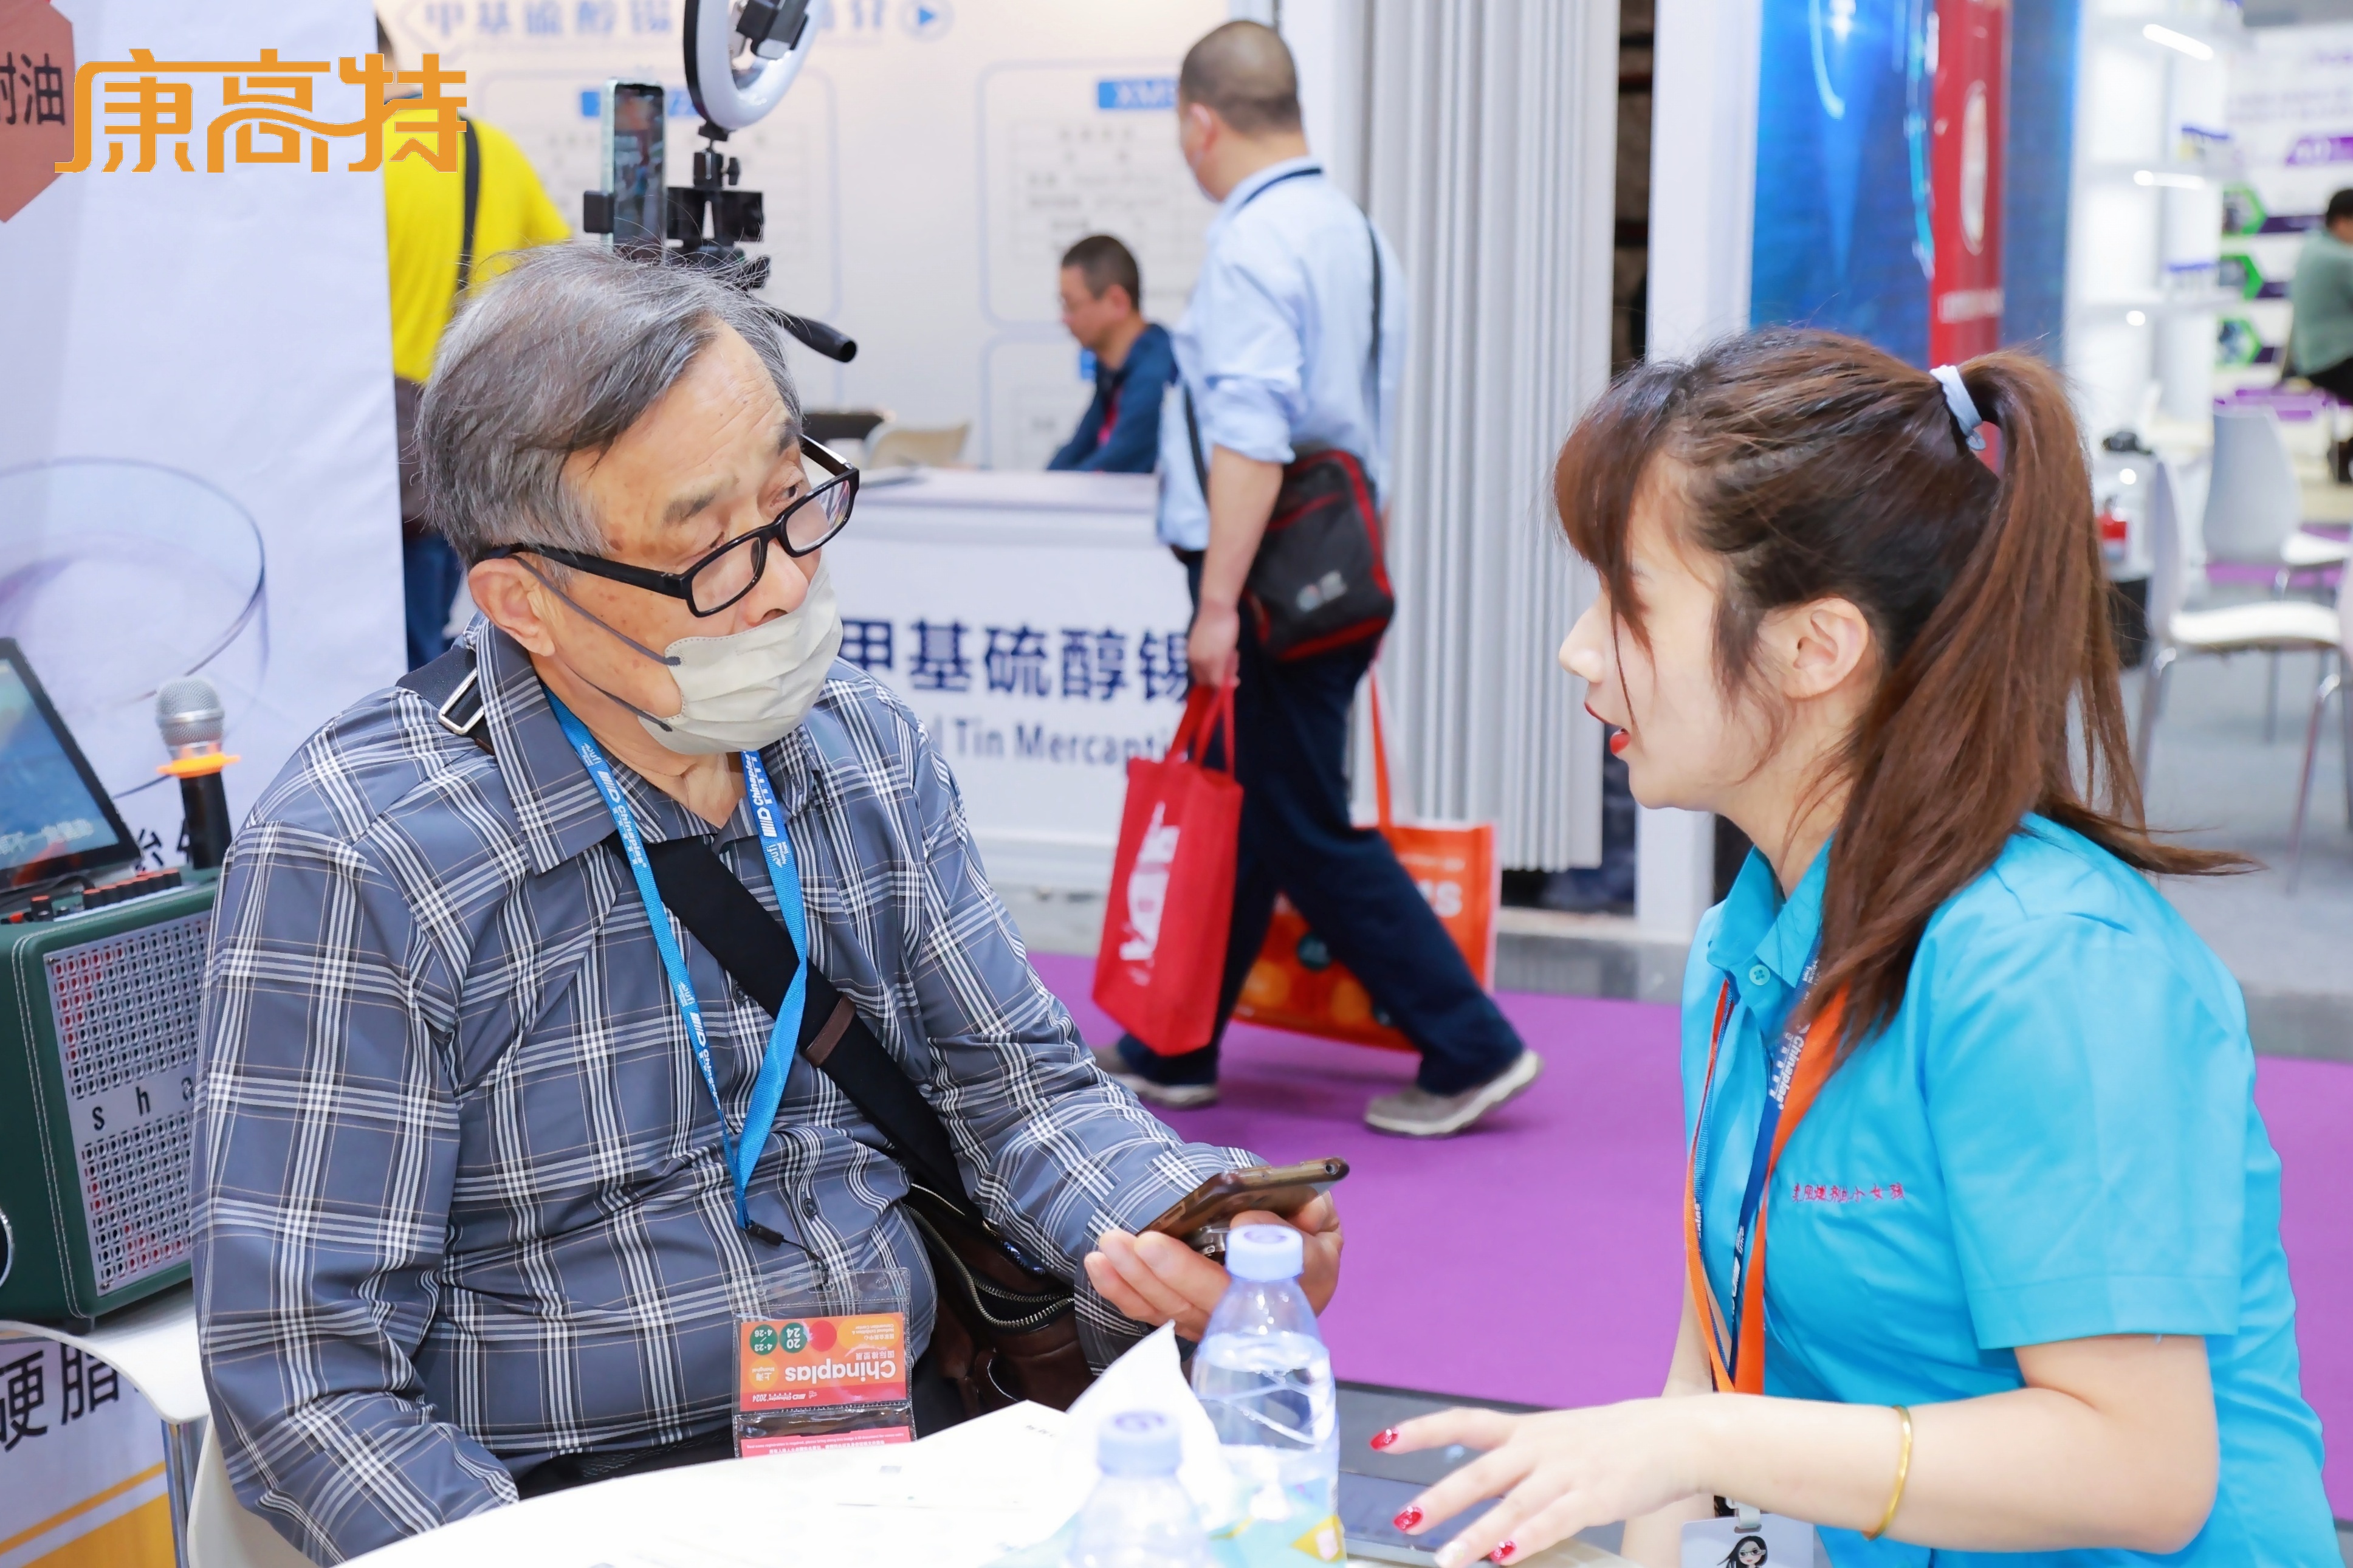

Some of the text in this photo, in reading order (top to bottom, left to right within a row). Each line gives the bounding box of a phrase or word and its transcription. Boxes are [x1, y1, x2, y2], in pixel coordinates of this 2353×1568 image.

[841, 617, 1187, 702] 甲基硫醇锡
[786, 1328, 800, 1338] 24
[786, 1338, 800, 1349] 20
[785, 1358, 896, 1384] Chinaplas
[755, 1373, 772, 1381] 上海
[752, 1394, 767, 1402] 2024
